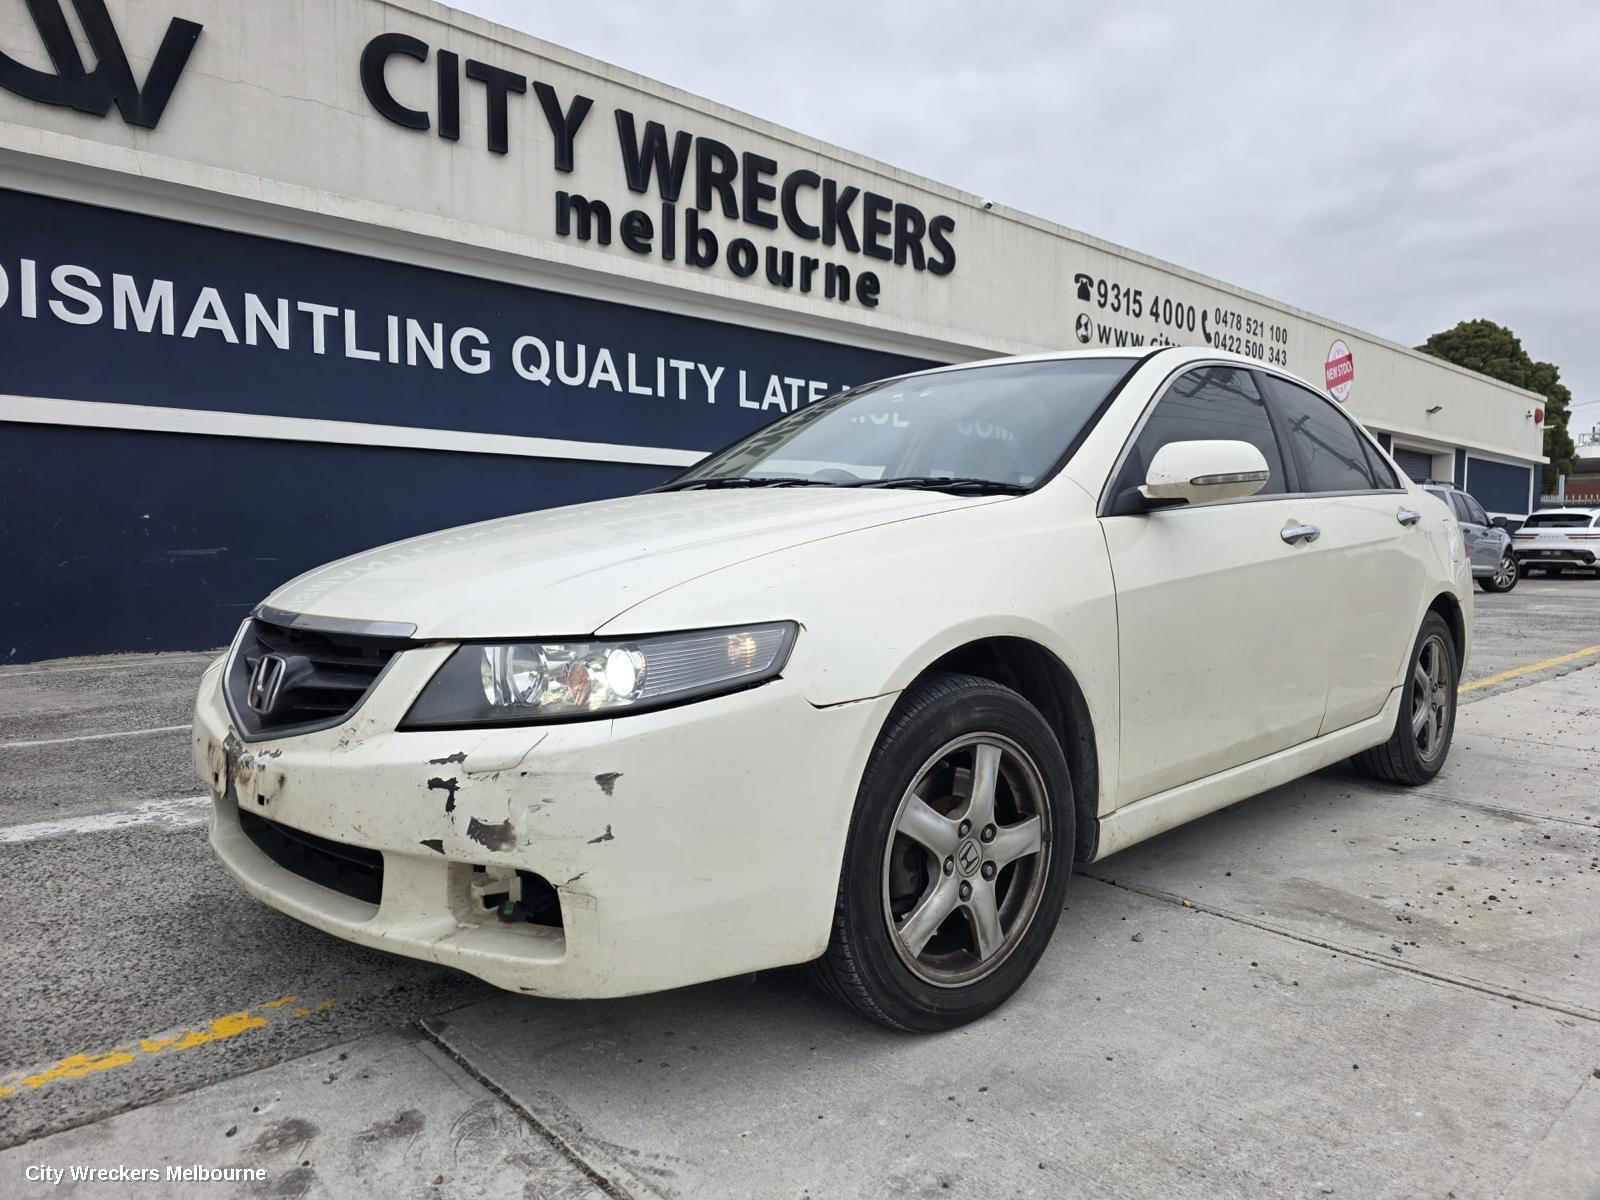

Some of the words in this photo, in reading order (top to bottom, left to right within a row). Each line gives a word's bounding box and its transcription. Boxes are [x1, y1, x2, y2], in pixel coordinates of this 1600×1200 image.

[359, 32, 594, 174] CITY
[614, 108, 957, 277] WRECKERS
[555, 190, 881, 308] melbourne
[0, 258, 491, 375] ISMANTLING
[512, 335, 725, 404] QUALITY
[1096, 278, 1144, 319] 9315
[1149, 294, 1196, 333] 4000
[1214, 307, 1242, 332] 0478
[1245, 316, 1264, 339] 521
[1269, 324, 1288, 345] 100
[1213, 331, 1242, 355] 0422
[1244, 339, 1264, 361] 500
[1268, 346, 1287, 367] 343
